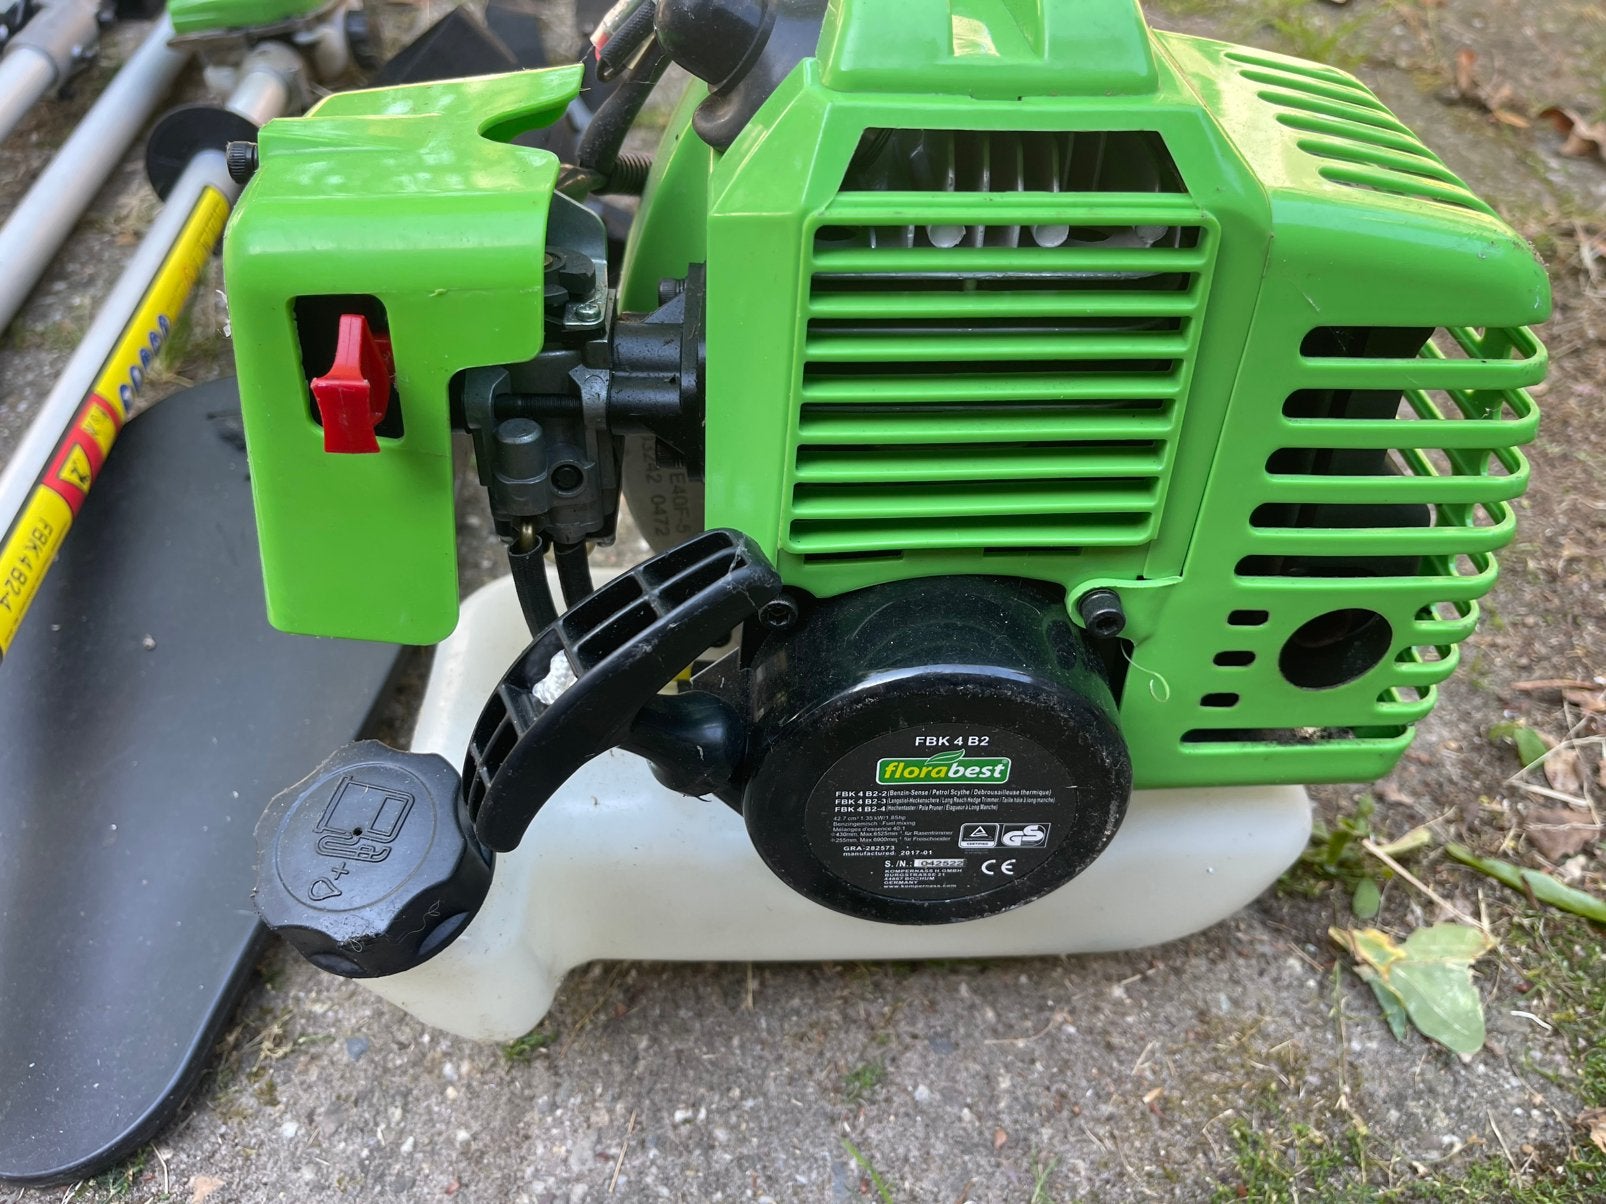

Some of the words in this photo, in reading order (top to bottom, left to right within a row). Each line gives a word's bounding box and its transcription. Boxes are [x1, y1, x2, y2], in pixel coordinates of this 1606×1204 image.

[26, 517, 53, 558] FBK
[915, 736, 950, 746] FBK
[954, 736, 963, 746] 4
[967, 736, 990, 746] B2
[884, 762, 1005, 779] florabest
[932, 789, 950, 797] Petrol
[950, 789, 971, 797] Scythe
